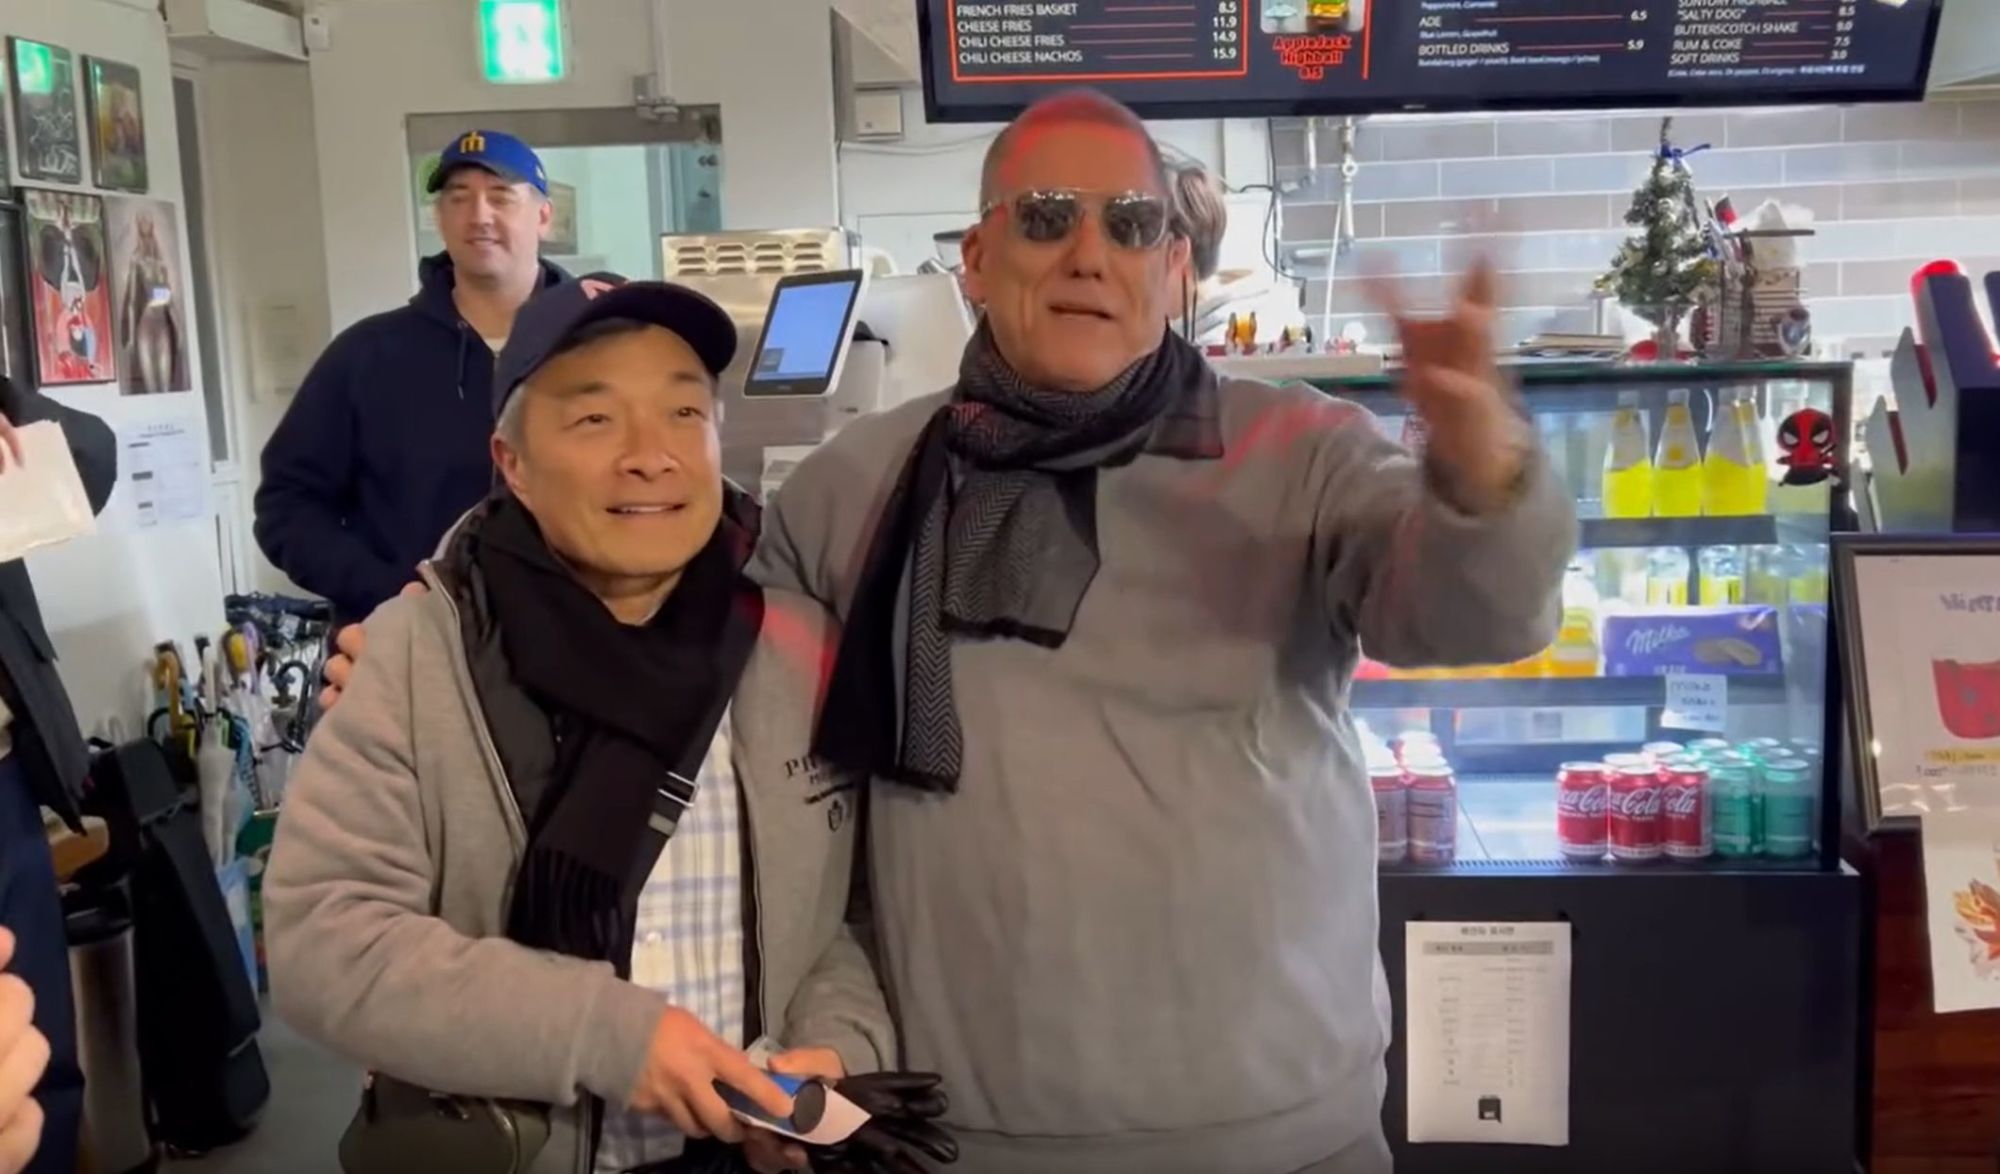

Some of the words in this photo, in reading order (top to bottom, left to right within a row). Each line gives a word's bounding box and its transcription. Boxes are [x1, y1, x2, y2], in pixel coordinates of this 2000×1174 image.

[957, 4, 1001, 17] FRENCH
[1003, 4, 1034, 16] FRIES
[1036, 3, 1078, 15] BASKET
[1218, 2, 1237, 14] 8.5
[1715, 8, 1746, 20] DOG"
[957, 21, 1000, 32] CHEESE
[1002, 20, 1032, 32] FRIES
[1213, 17, 1237, 28] 11.9
[1419, 16, 1442, 28] ADE
[1674, 23, 1761, 36] BUTTERSCOTCH
[1762, 21, 1799, 34] SHAKE
[959, 36, 988, 48] CHILI
[989, 35, 1032, 47] CHEESE
[1034, 34, 1064, 47] FRIES
[1213, 31, 1237, 43] 14.9
[1673, 40, 1700, 50] RUM
[1701, 39, 1711, 50] &
[1712, 38, 1743, 50] COKE
[1418, 44, 1468, 56] BOTTLED
[1469, 42, 1510, 55] DRINKS
[1627, 39, 1645, 50] 5.9
[959, 52, 988, 64] CHILI
[989, 51, 1032, 63] CHEESE
[1034, 50, 1083, 62] NACHOS
[1213, 47, 1237, 59] 15.9
[1670, 53, 1699, 65] SOFT
[1700, 52, 1740, 63] DRINKS
[1625, 624, 1691, 655] Milka
